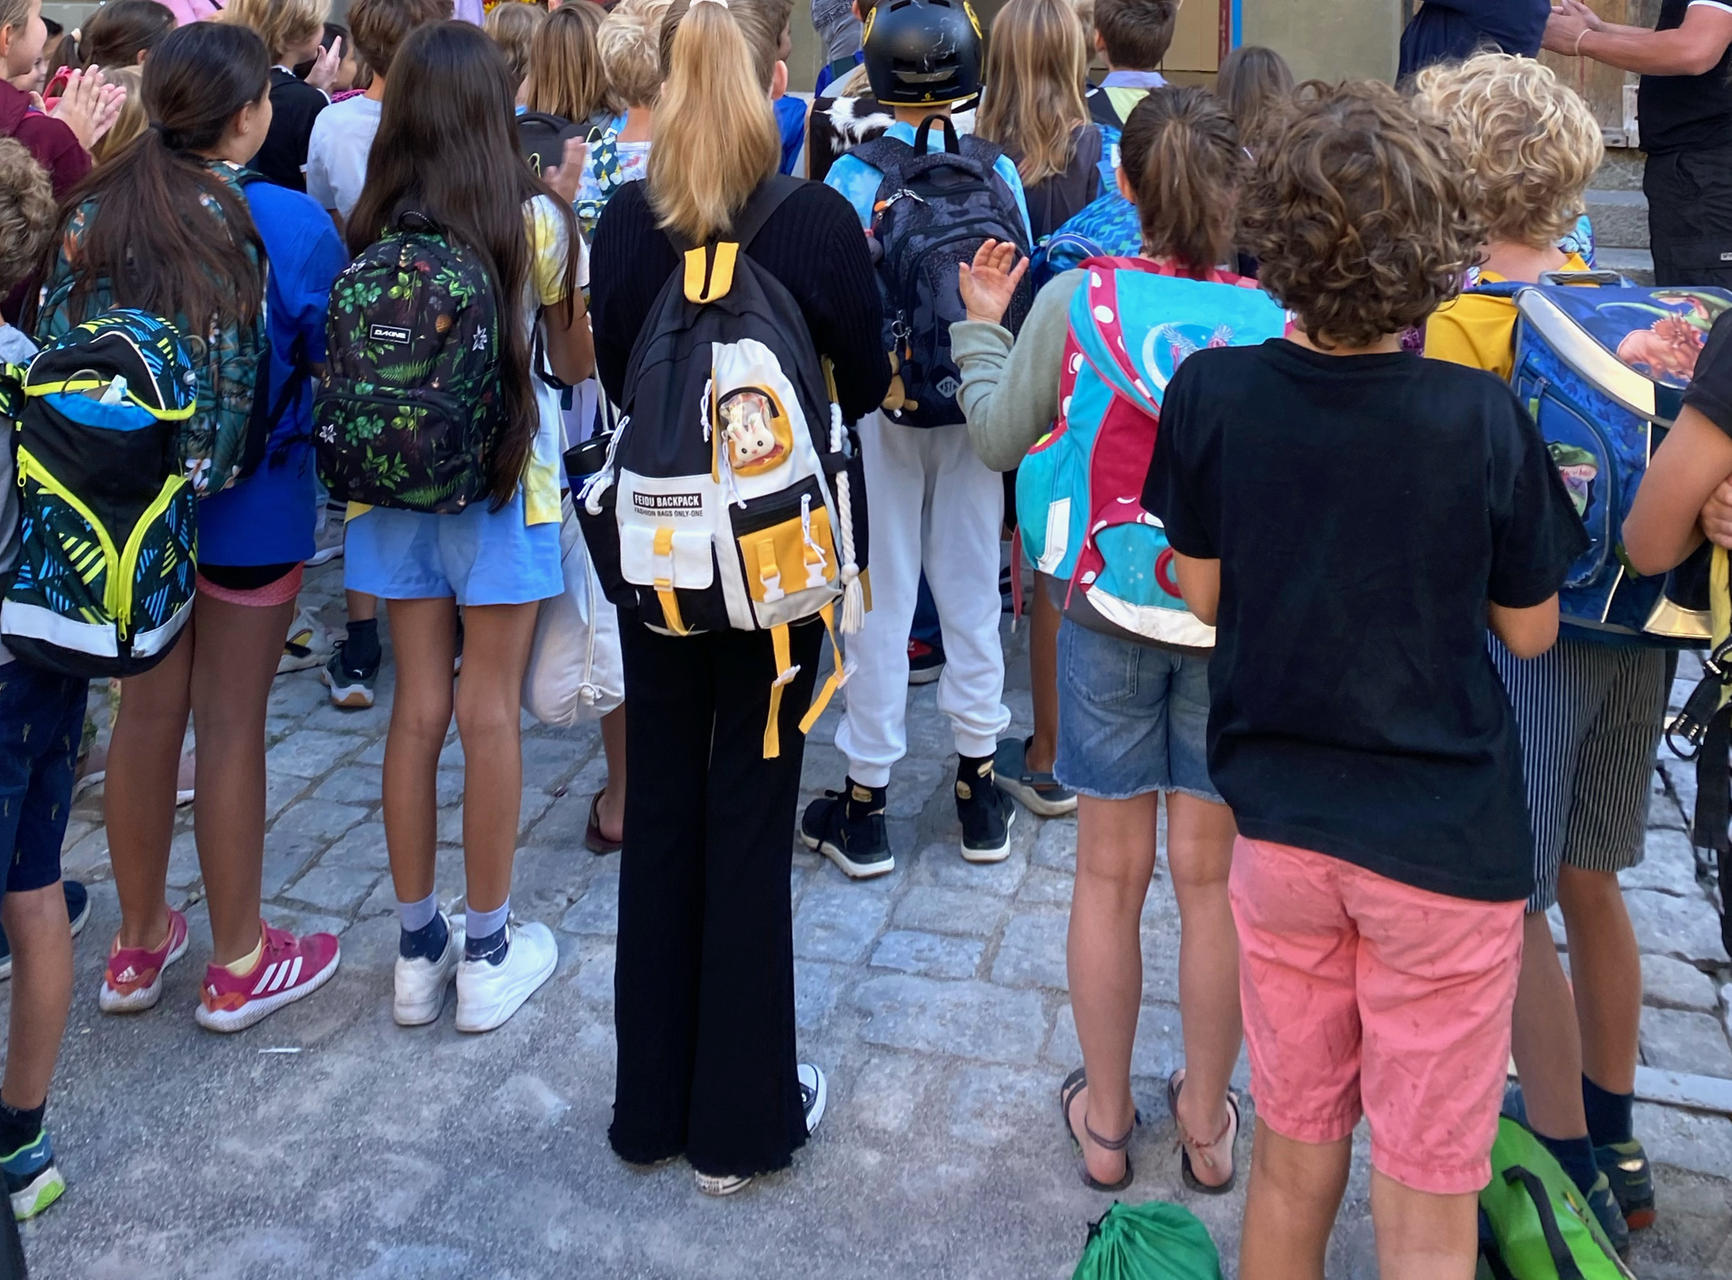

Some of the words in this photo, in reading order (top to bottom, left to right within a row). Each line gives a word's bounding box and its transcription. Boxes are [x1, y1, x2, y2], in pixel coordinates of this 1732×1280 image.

[374, 329, 407, 339] DAKINE
[656, 495, 700, 507] BACKPACK
[657, 509, 673, 517] BAGS
